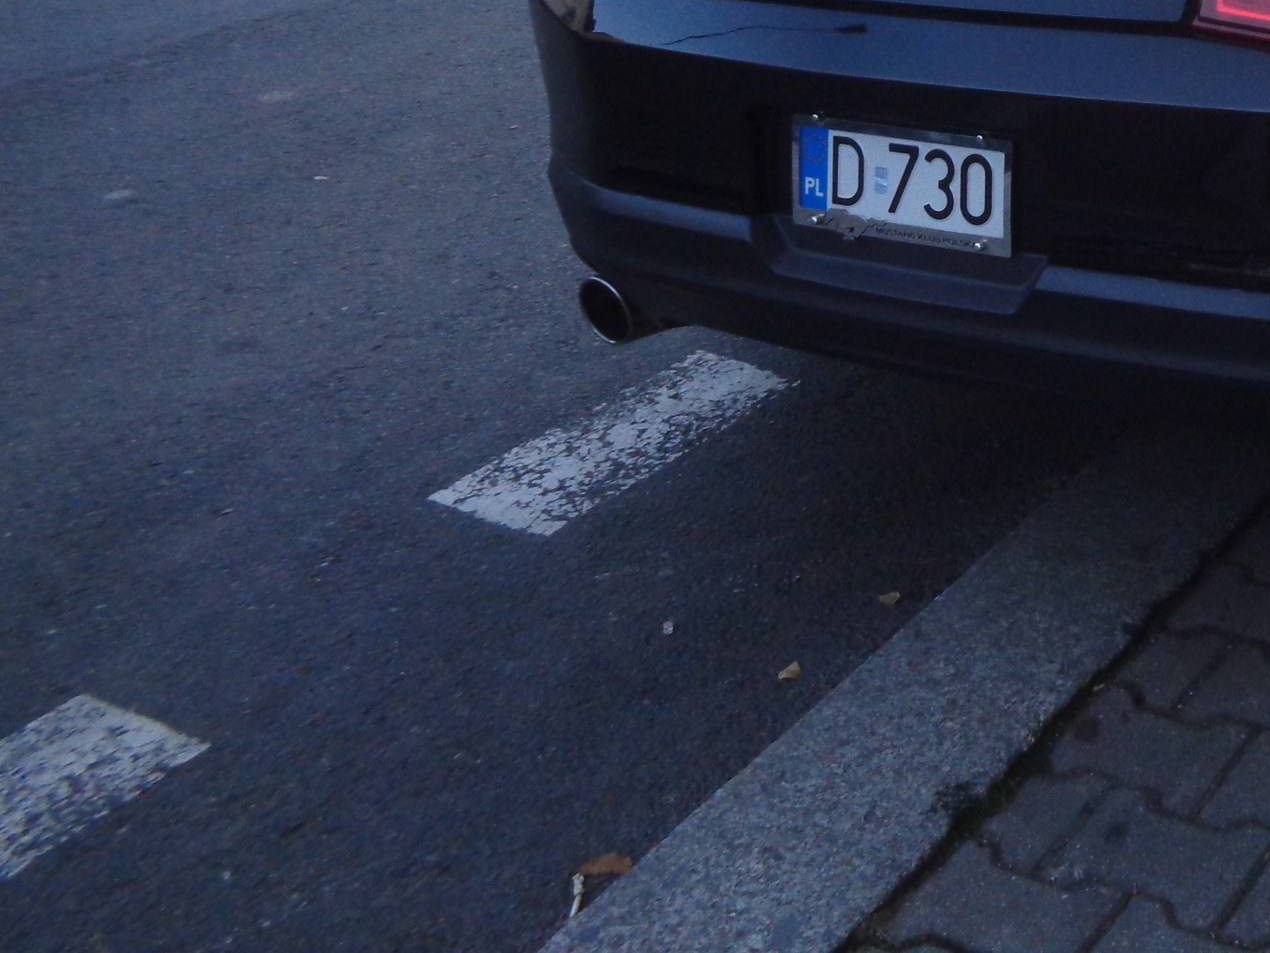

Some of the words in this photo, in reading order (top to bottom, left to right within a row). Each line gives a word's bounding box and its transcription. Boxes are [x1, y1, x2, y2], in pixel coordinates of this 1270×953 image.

[804, 176, 824, 198] PL
[831, 135, 865, 206] D
[888, 142, 993, 226] 730
